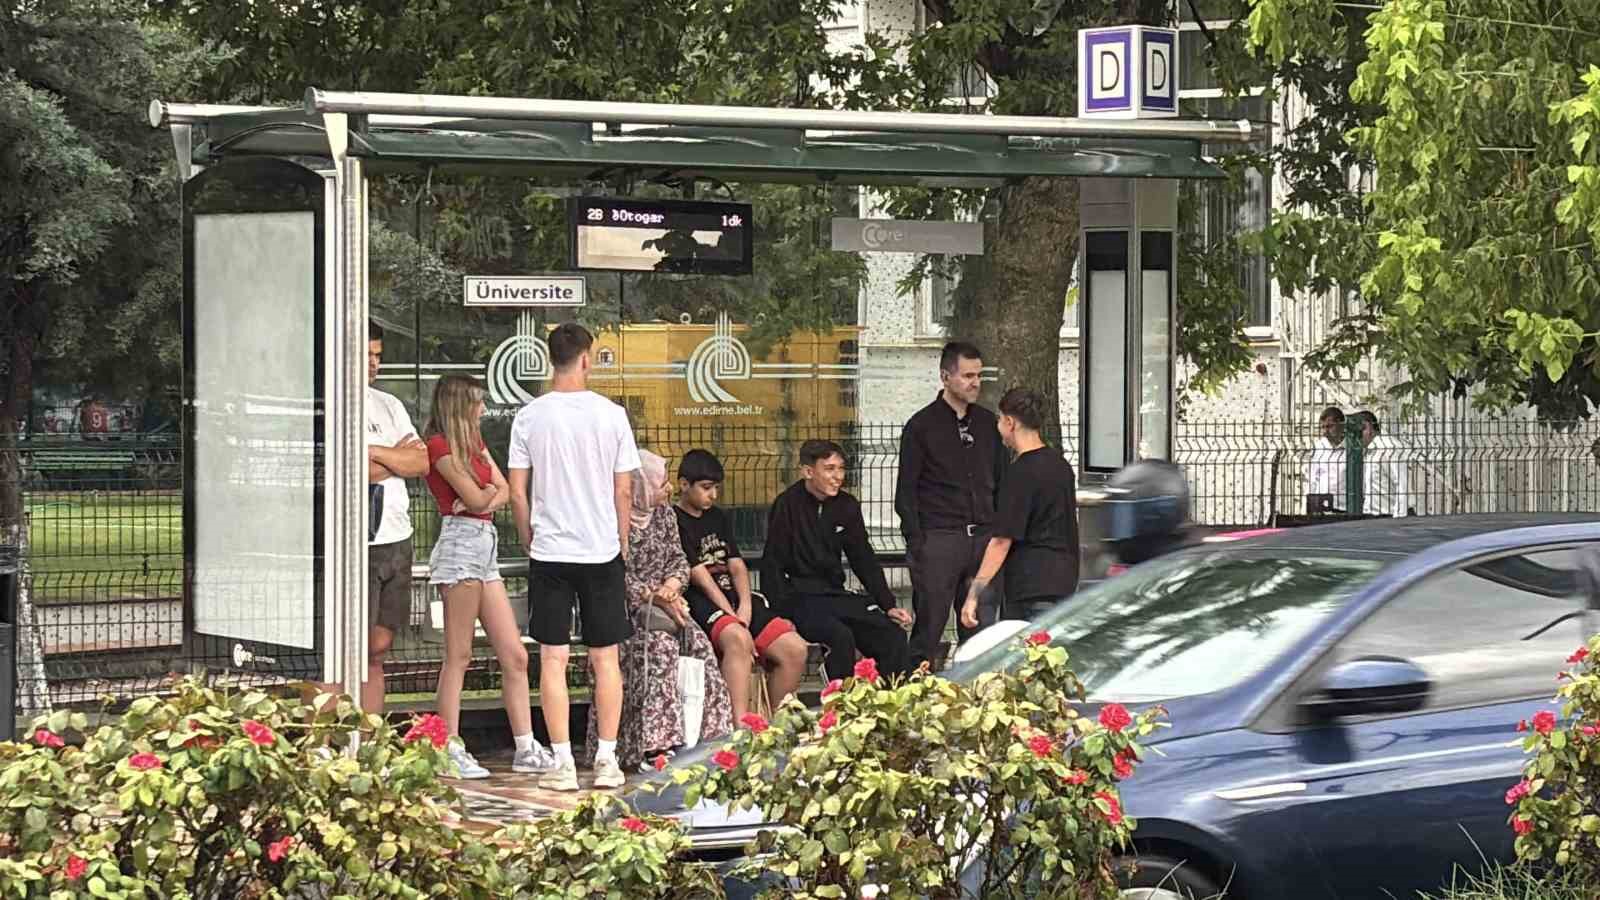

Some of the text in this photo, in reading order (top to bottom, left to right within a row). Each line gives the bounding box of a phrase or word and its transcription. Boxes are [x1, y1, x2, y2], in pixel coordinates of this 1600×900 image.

[1101, 51, 1119, 91] D
[1152, 49, 1166, 90] D
[476, 281, 573, 299] Üniversite
[92, 412, 102, 428] 9
